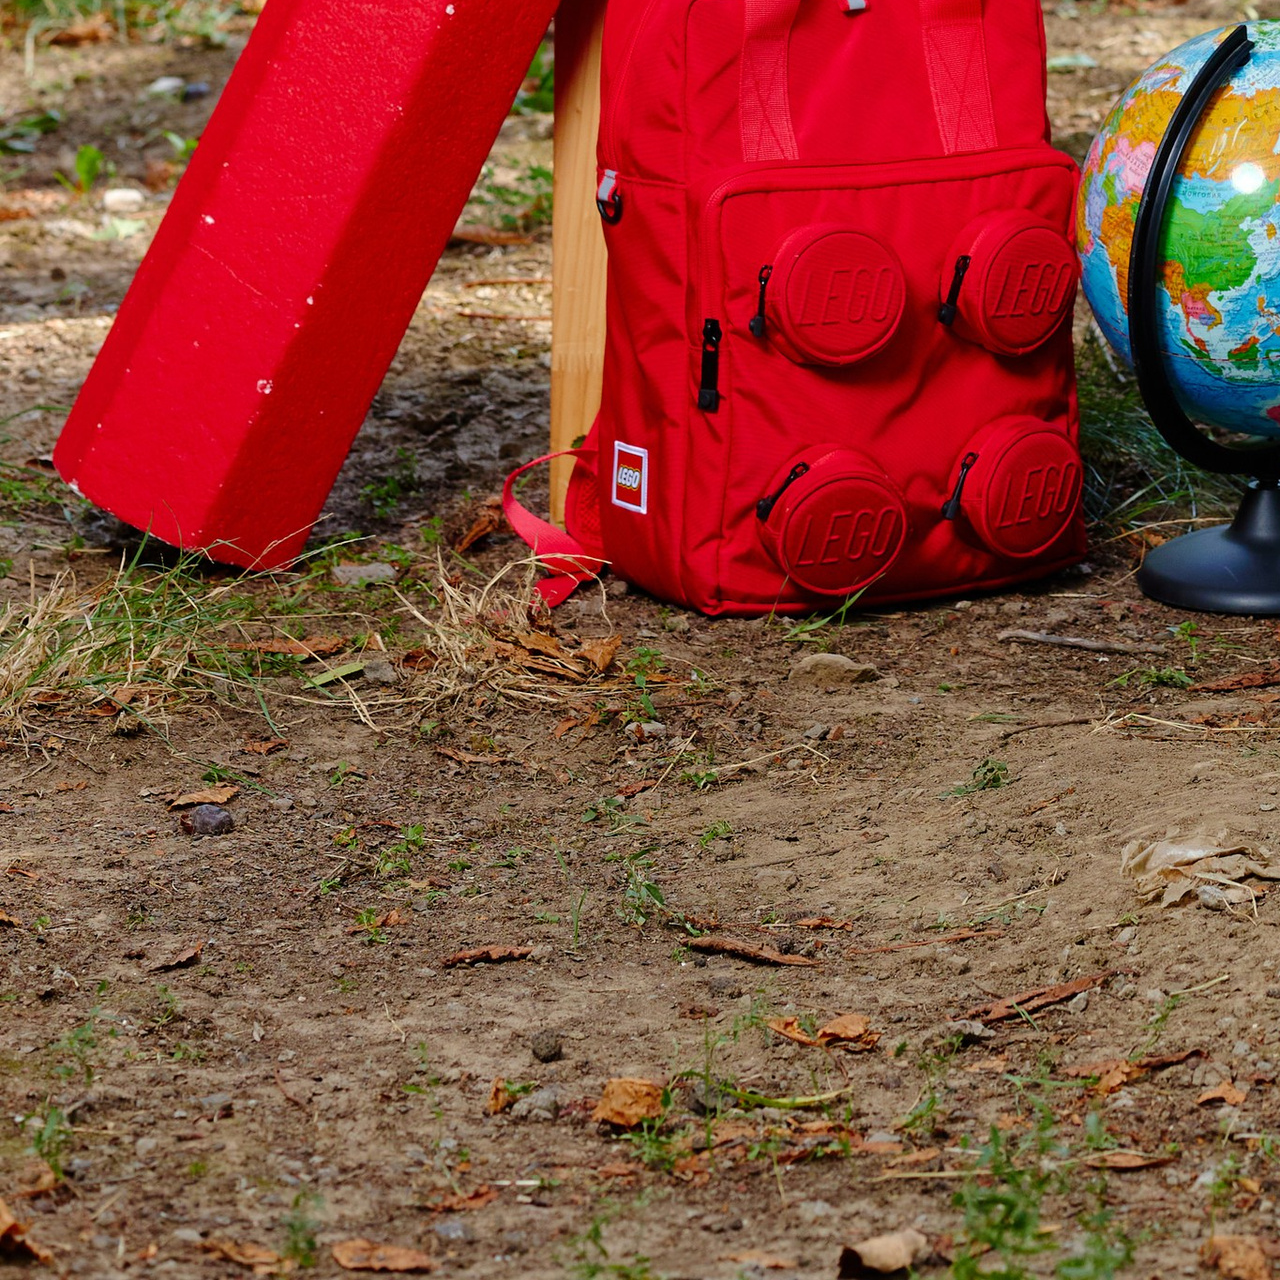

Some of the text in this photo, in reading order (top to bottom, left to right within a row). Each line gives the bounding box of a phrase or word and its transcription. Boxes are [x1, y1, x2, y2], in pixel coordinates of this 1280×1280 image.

[796, 267, 894, 327] LEGO
[991, 262, 1073, 320] LEGO
[617, 466, 640, 489] LEGO
[995, 461, 1079, 530] LEGO
[795, 506, 898, 568] LEGO
